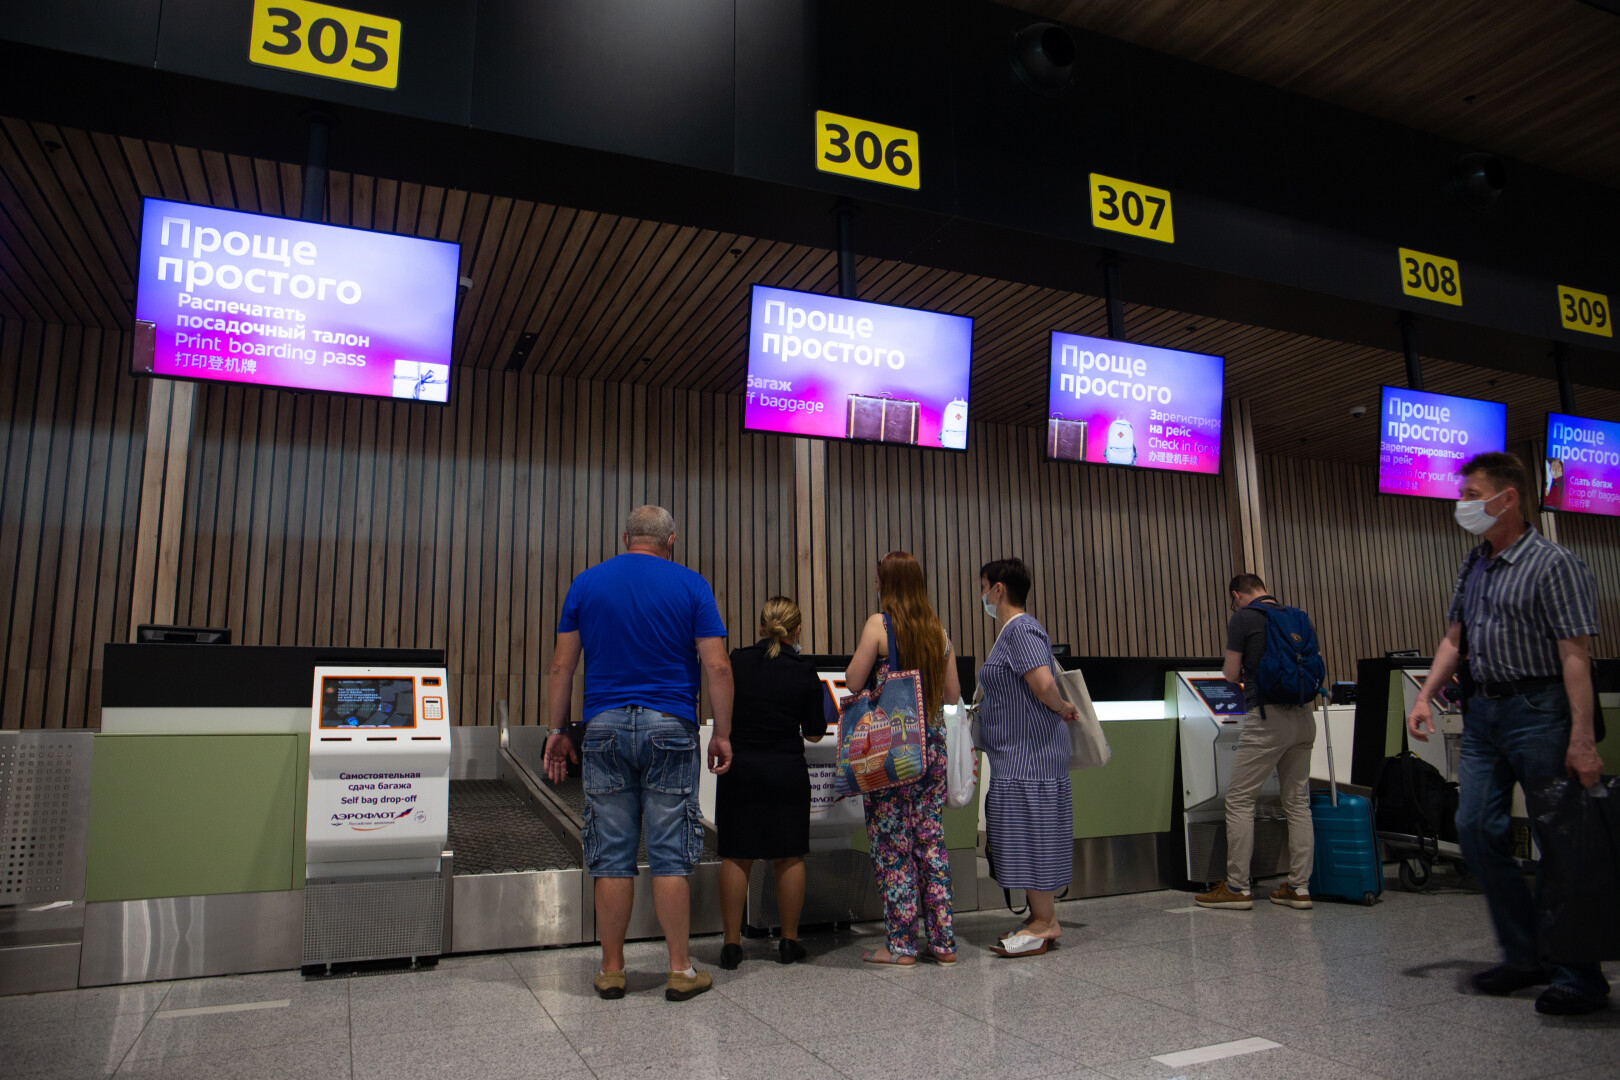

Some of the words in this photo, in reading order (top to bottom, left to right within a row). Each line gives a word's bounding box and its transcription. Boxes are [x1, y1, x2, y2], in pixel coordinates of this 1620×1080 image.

[262, 8, 388, 72] 305
[824, 124, 912, 176] 306
[1098, 185, 1165, 230] 307
[160, 216, 317, 267] Проще
[157, 256, 362, 305] простого
[1405, 257, 1456, 296] 308
[178, 293, 306, 322] Распечатать
[1563, 294, 1606, 327] 309
[176, 314, 306, 341] посадочный
[312, 329, 370, 348] талон
[764, 300, 873, 340] Проще
[175, 333, 221, 352] Print
[228, 338, 316, 365] boarding
[323, 349, 366, 369] pass
[762, 333, 905, 370] простого
[1061, 344, 1147, 378] Проще
[175, 352, 257, 375] 打印登机牌
[1060, 373, 1172, 404] простого
[760, 393, 824, 414] baggage
[1389, 397, 1450, 424] Проще
[1150, 424, 1162, 434] на
[1166, 425, 1191, 437] рейс
[1388, 421, 1468, 445] простого
[1553, 422, 1605, 446] Проще
[1149, 437, 1179, 450] Check
[1182, 440, 1191, 451] in
[1195, 442, 1208, 453] for
[1380, 441, 1464, 459] Зарегистрироваться
[1552, 445, 1619, 466] простого
[1393, 455, 1413, 466] рейс
[1428, 472, 1446, 482] your
[1570, 476, 1590, 486] Сдать
[1592, 478, 1613, 489] багаж
[1587, 490, 1597, 498] off
[340, 772, 421, 780] Самостоятельная
[378, 782, 412, 790] багажа
[341, 796, 359, 804] Self
[361, 796, 378, 805] bag
[380, 795, 417, 804] drop-off
[331, 811, 396, 820] АЭРОФЛОТ
